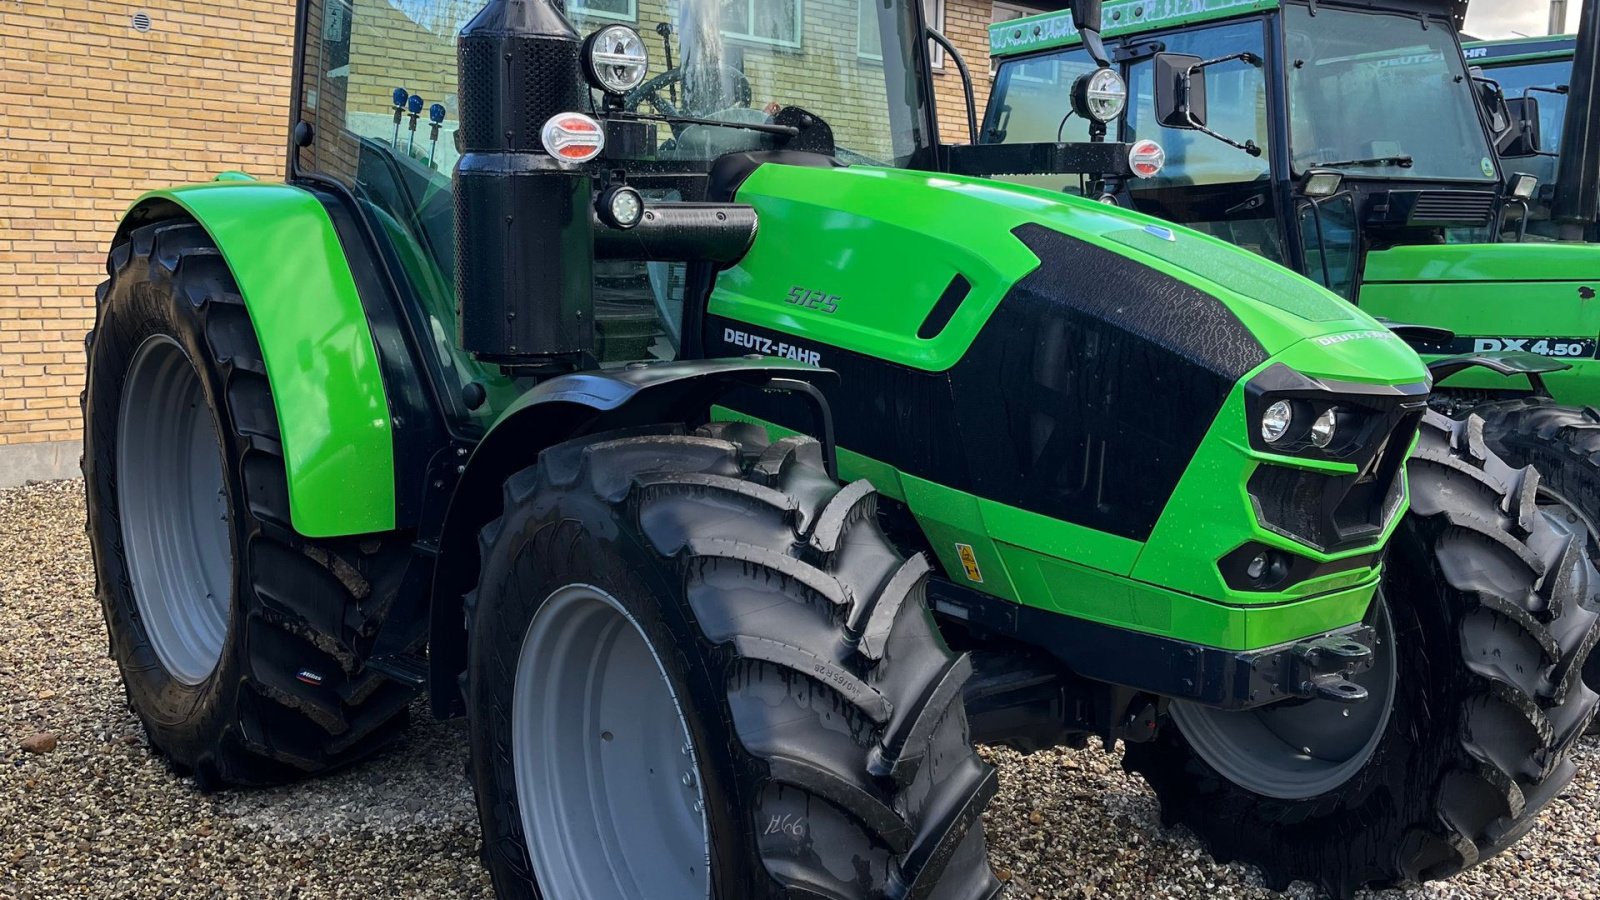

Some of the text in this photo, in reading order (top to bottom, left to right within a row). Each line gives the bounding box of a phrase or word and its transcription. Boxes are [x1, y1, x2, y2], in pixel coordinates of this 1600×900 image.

[784, 286, 841, 314] 5125
[723, 328, 821, 368] DEUTZ-FAHR
[1317, 331, 1394, 346] DEUTZ-F
[1530, 340, 1583, 356] 4.50
